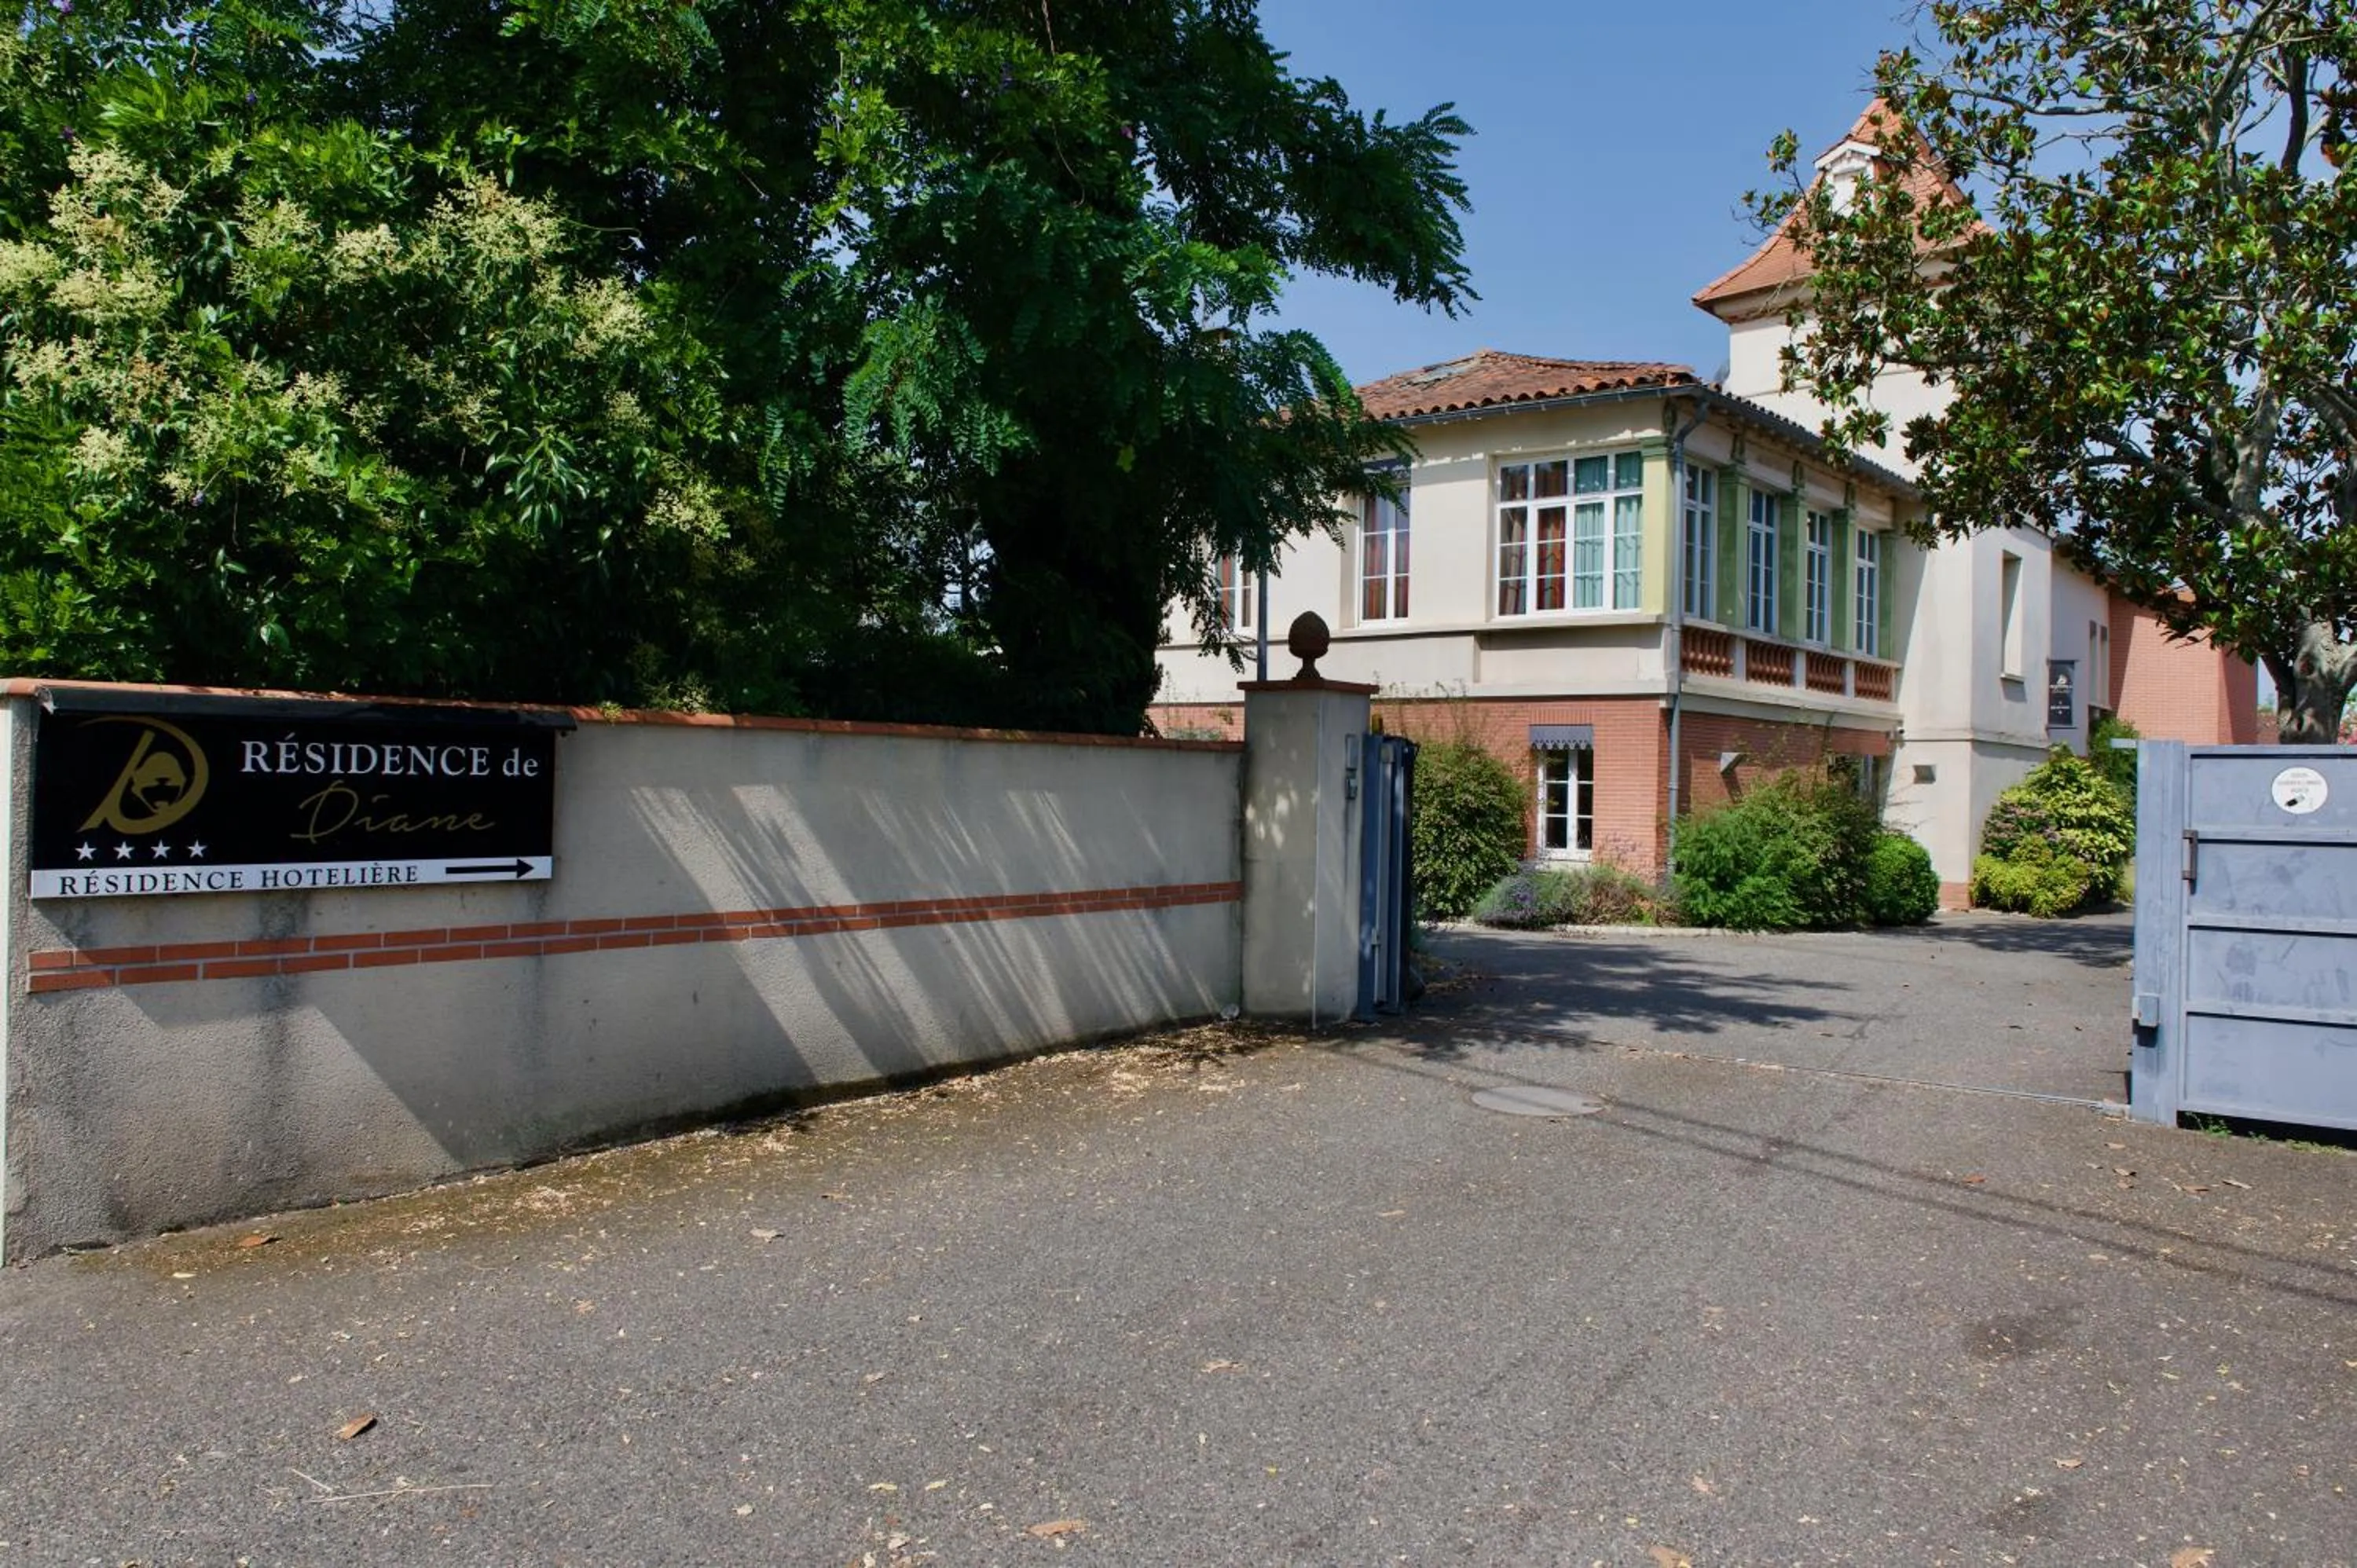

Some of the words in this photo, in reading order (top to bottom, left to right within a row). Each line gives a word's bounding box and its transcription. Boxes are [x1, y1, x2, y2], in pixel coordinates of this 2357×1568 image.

[240, 732, 490, 776] RÉSIDENCE
[502, 747, 539, 777] de
[290, 779, 496, 844] Diane
[59, 870, 244, 895] RÉSIDENCE
[262, 862, 418, 887] HOTELIÈRE
